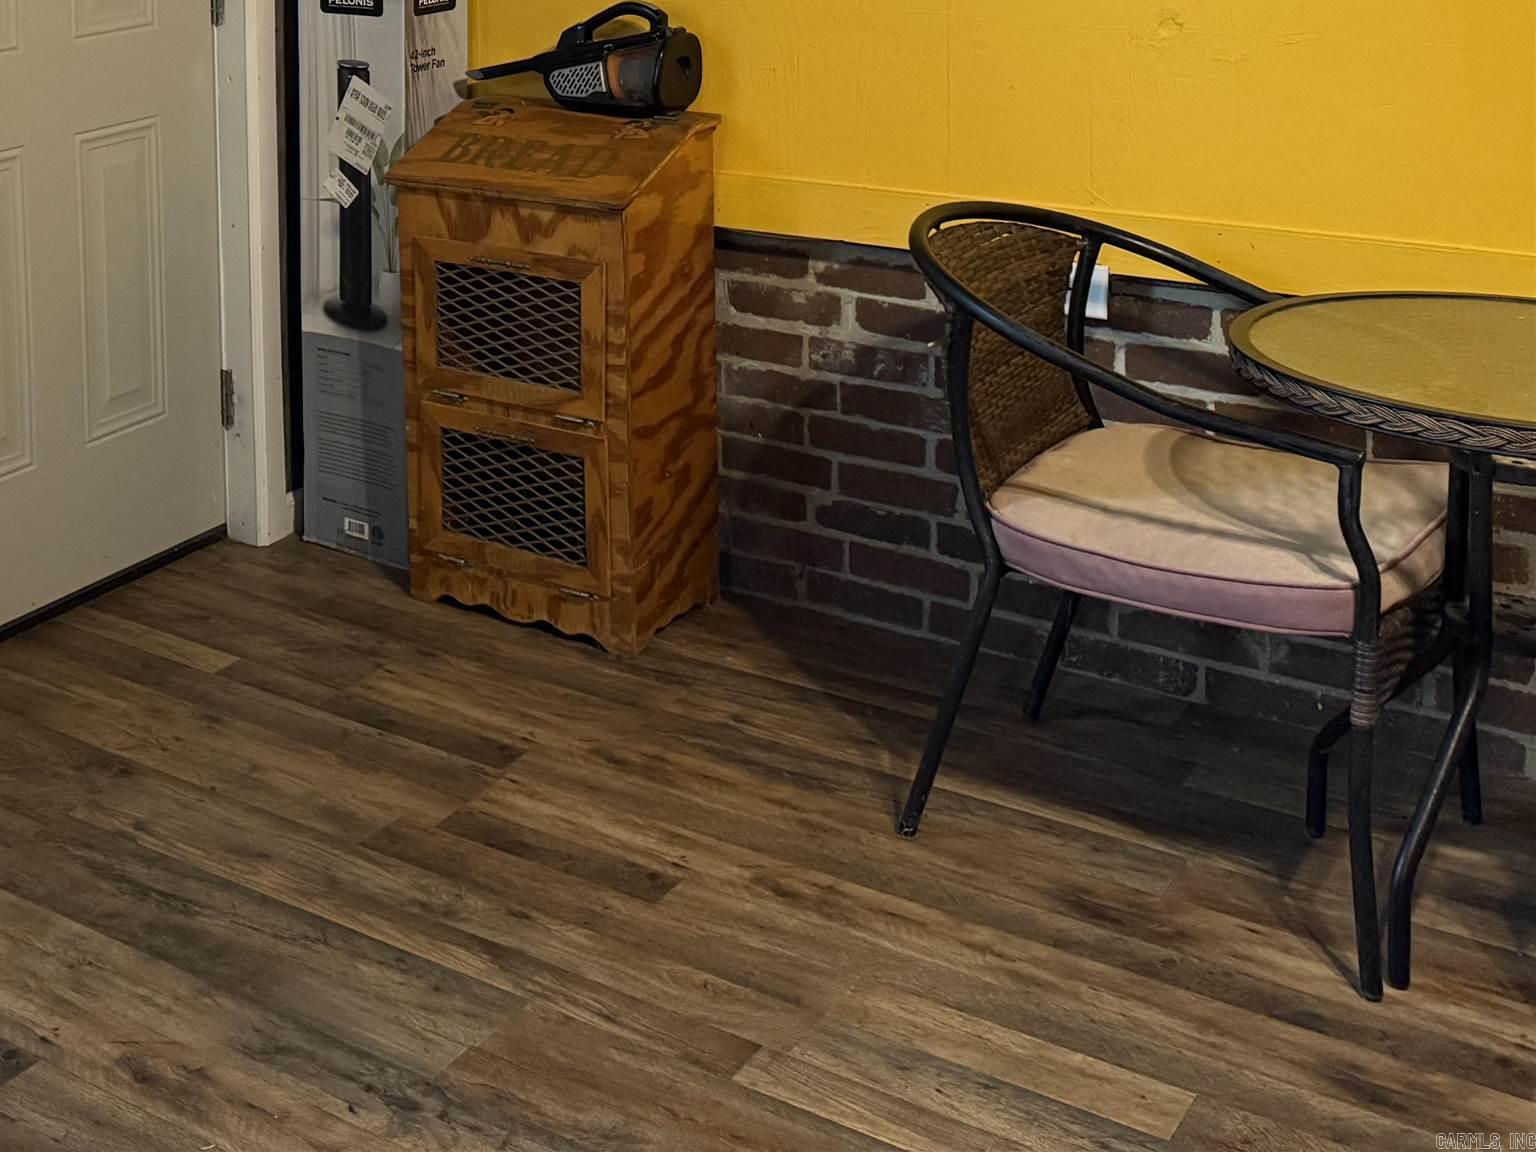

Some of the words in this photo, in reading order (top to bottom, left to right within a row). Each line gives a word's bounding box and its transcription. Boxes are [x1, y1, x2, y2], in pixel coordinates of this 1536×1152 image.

[410, 61, 430, 73] Tower
[431, 59, 445, 69] Fan
[440, 133, 620, 179] BREAD
